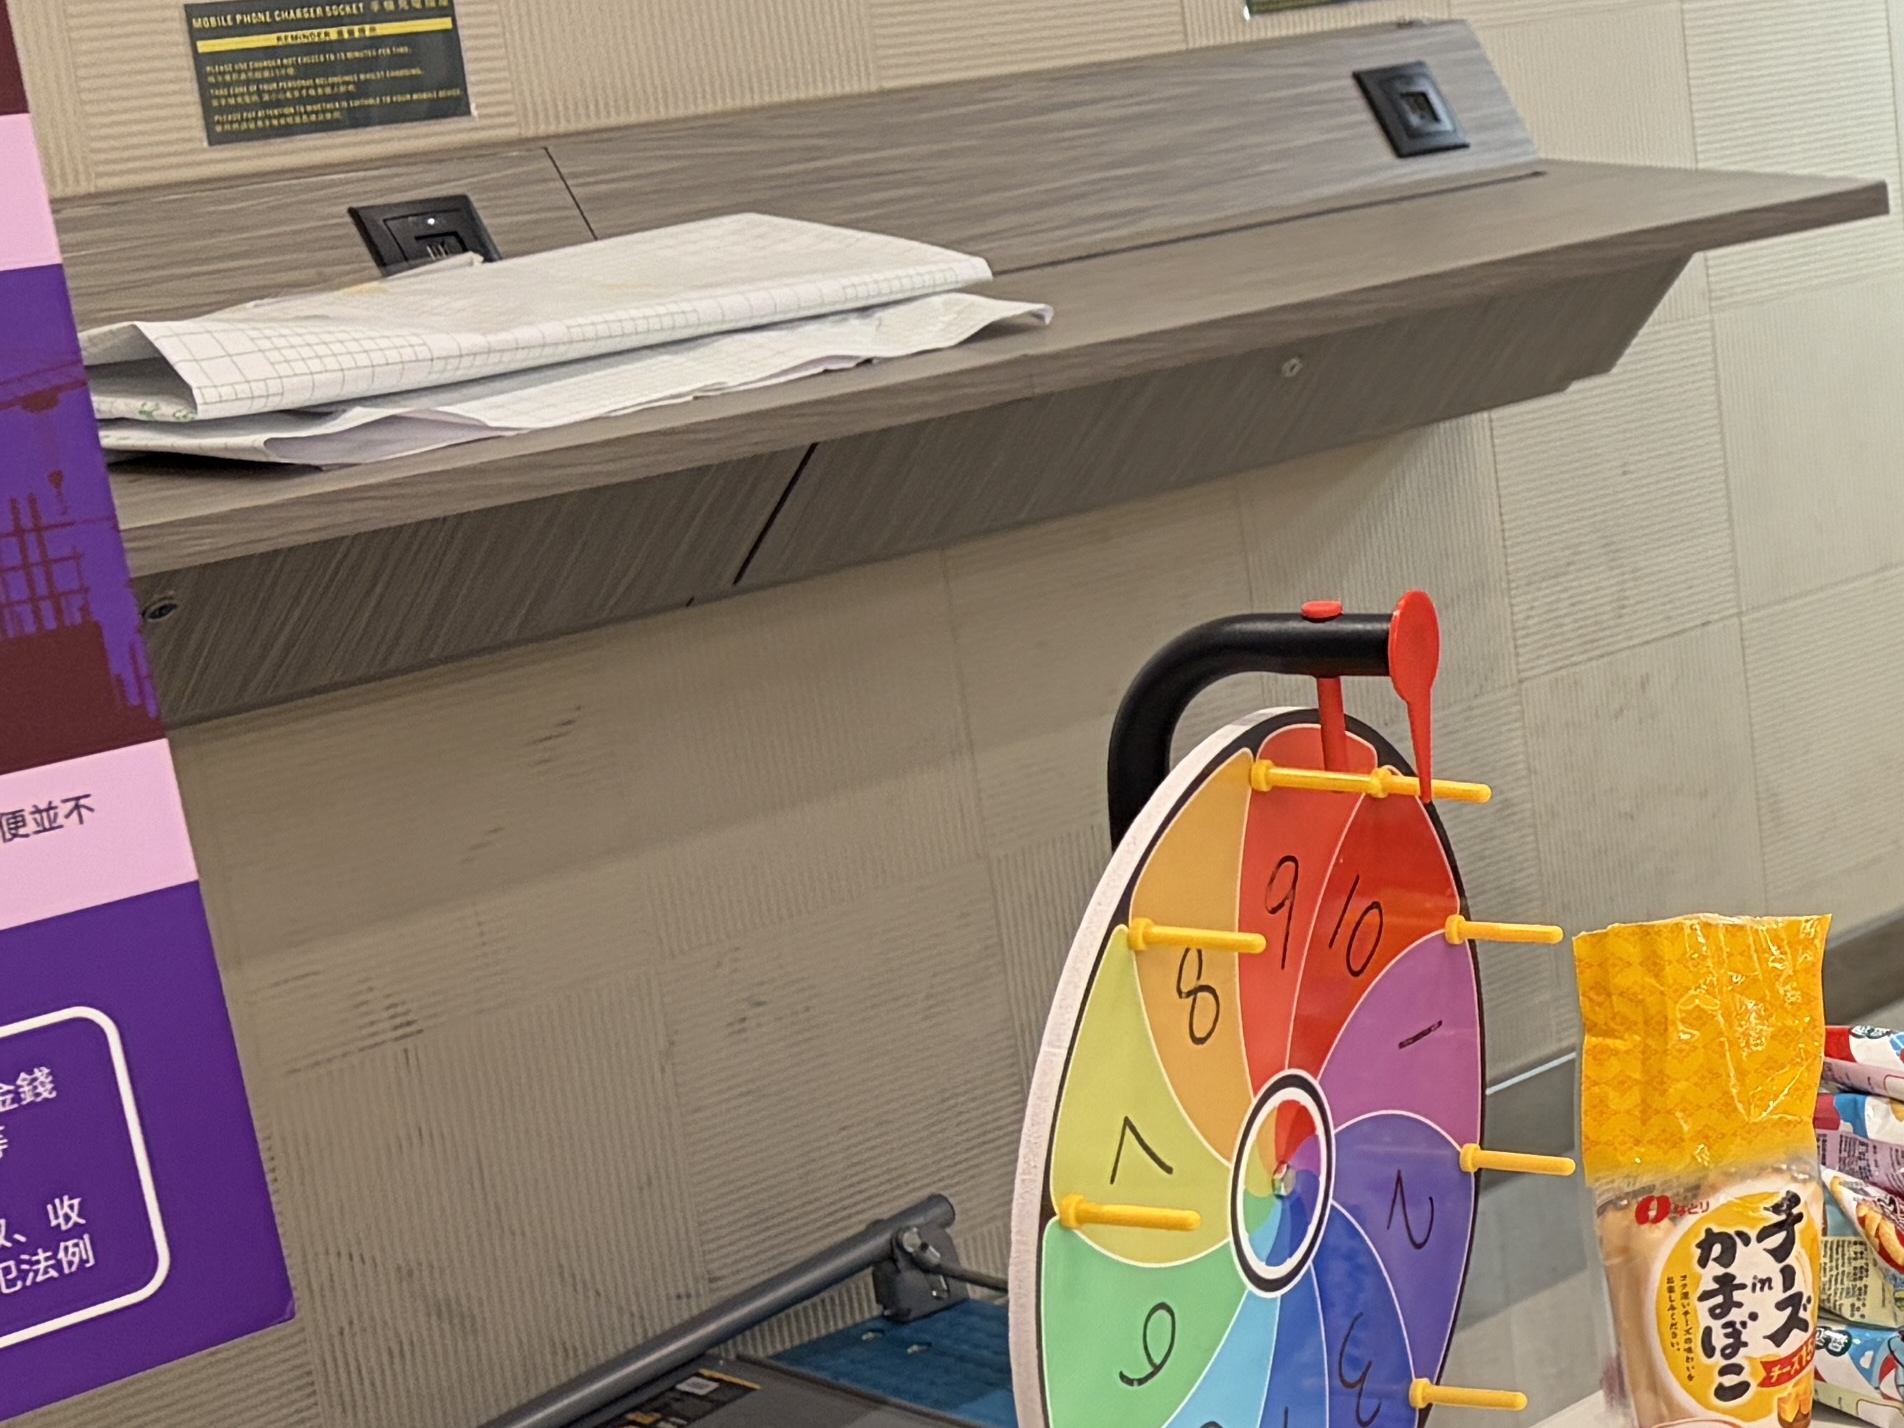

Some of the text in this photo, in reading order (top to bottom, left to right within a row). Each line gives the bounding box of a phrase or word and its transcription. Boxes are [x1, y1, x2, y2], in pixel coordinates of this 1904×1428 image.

[192, 12, 233, 29] MOBILE
[235, 8, 272, 26] PHONE
[274, 4, 323, 22] CHARGER
[325, 2, 365, 19] SOCKET
[1673, 1200, 1711, 1217] なとり
[1755, 1189, 1813, 1348] チーズ
[1750, 1274, 1775, 1295] in
[1696, 1226, 1759, 1403] かまぼこ
